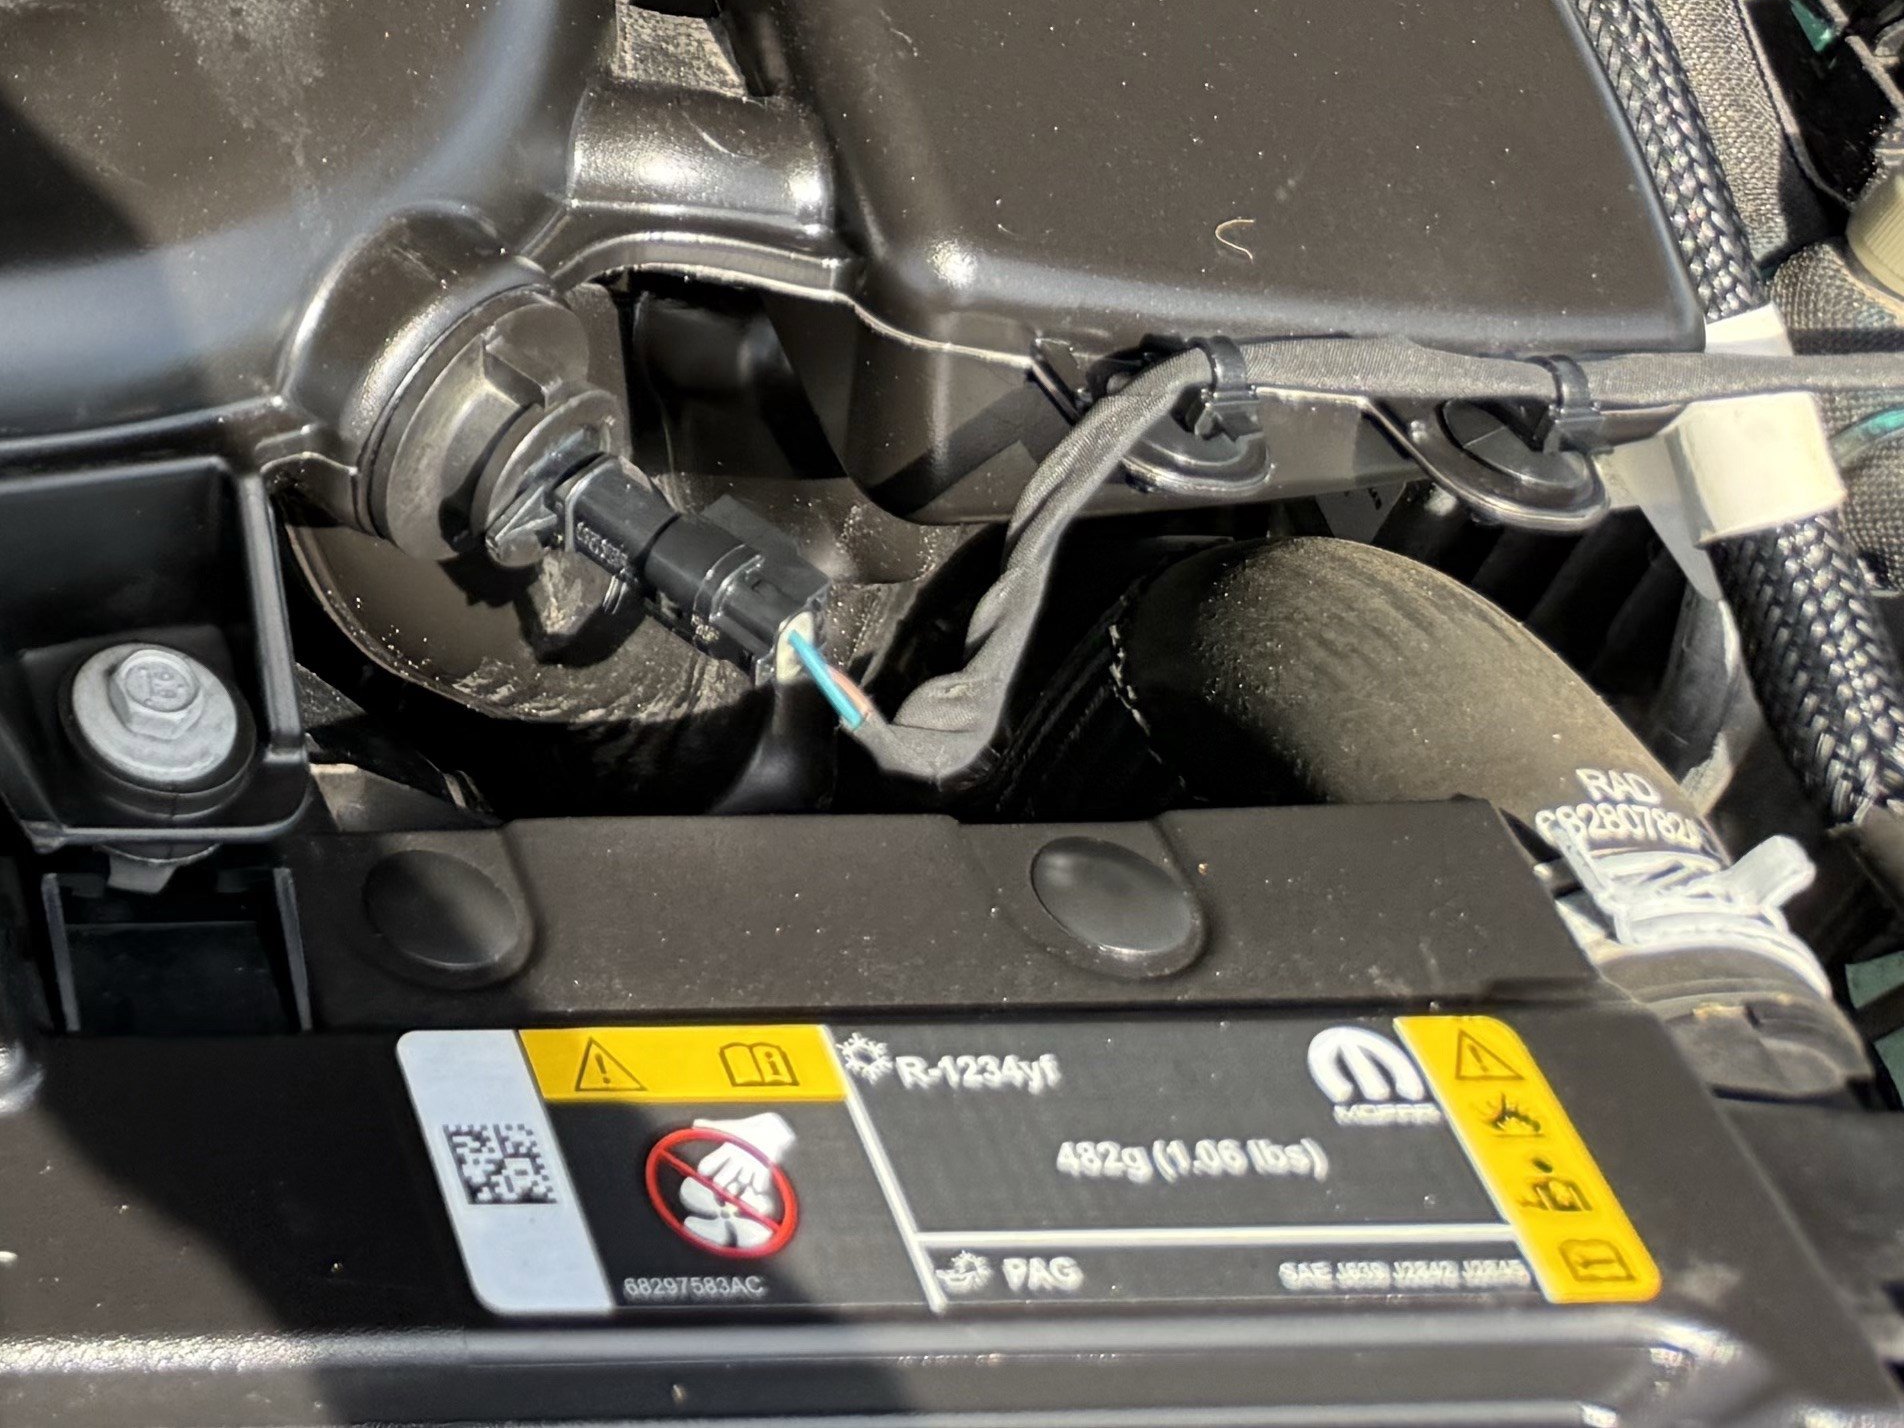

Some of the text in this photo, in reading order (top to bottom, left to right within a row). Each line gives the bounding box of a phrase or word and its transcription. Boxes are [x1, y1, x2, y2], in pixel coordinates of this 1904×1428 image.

[1576, 768, 1662, 805] RAD
[895, 1054, 1061, 1094] R-1234yf
[1057, 1138, 1329, 1184] 482g (1.06 lbs)
[623, 1275, 766, 1300] 68297583AC
[1003, 1256, 1084, 1291] PAG
[1279, 1261, 1333, 1290] SAE
